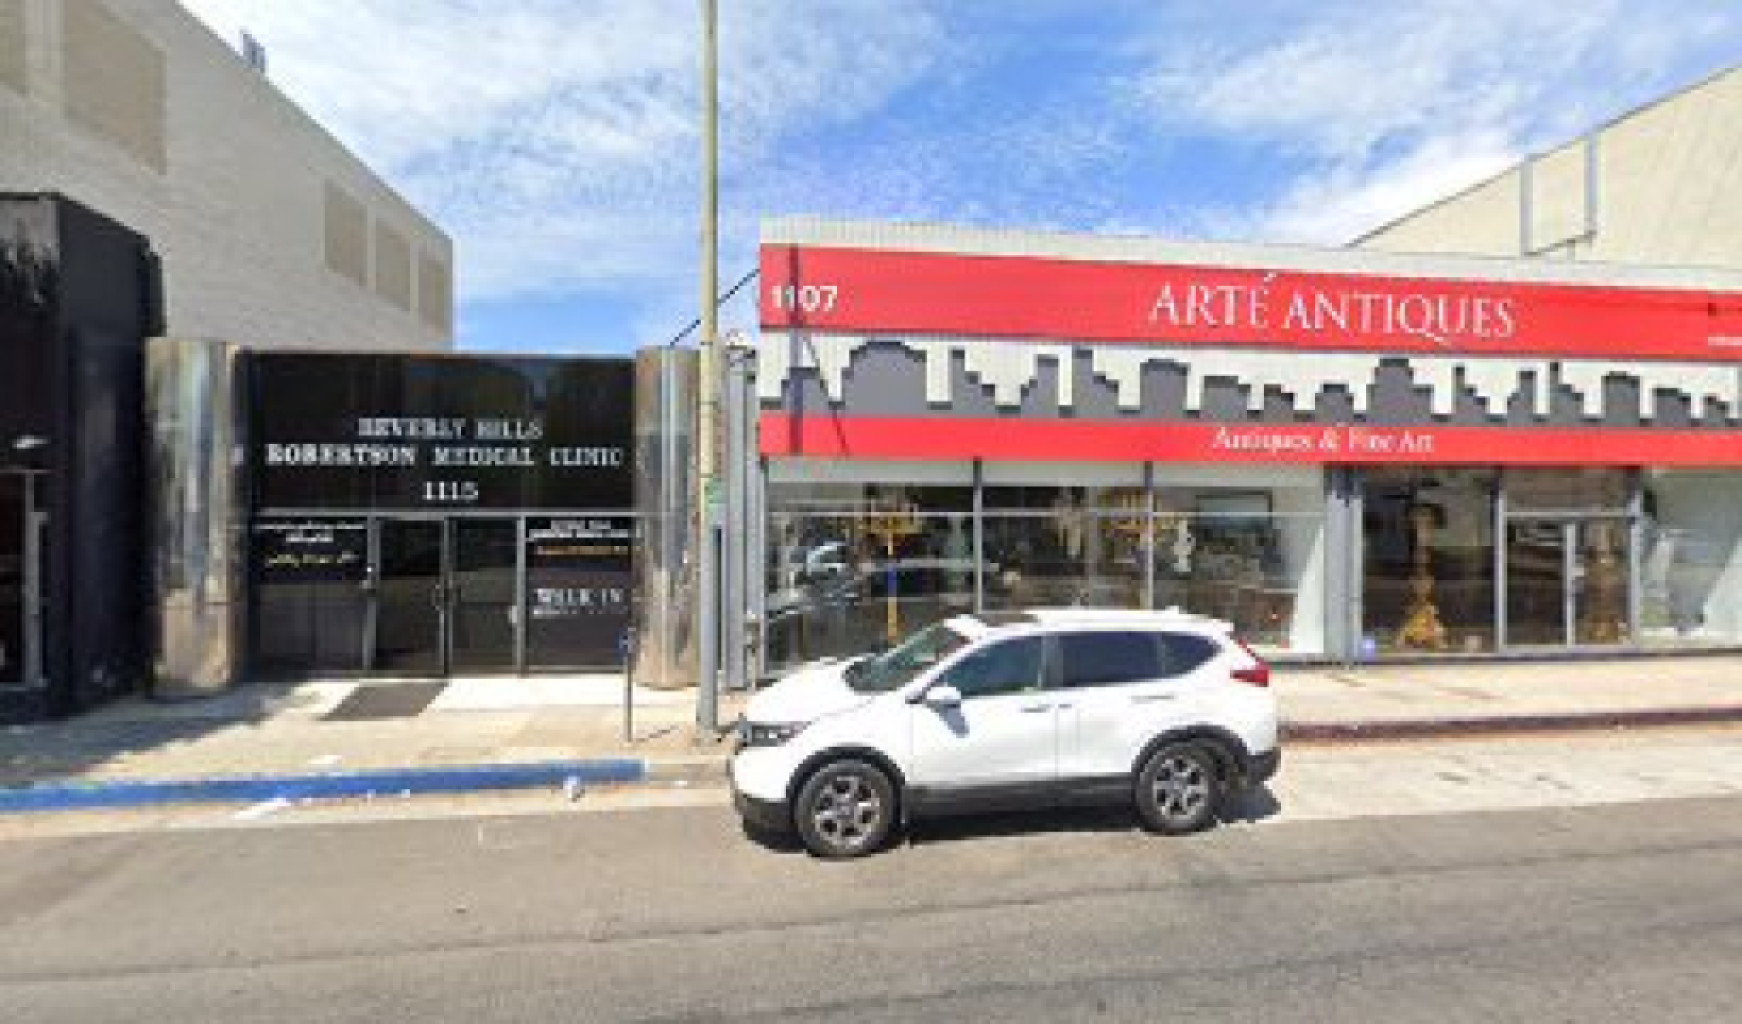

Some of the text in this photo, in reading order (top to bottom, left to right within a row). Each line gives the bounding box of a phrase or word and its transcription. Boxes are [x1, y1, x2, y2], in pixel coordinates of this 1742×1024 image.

[771, 285, 837, 312] 1107
[1284, 293, 1516, 345] ANTIQUES
[358, 417, 543, 439] BEVERLY HILLS
[1212, 426, 1434, 454] Antiques & Fine Art
[266, 444, 623, 466] ROBERTSON MEDICAL CLINIC
[423, 481, 478, 500] 1115
